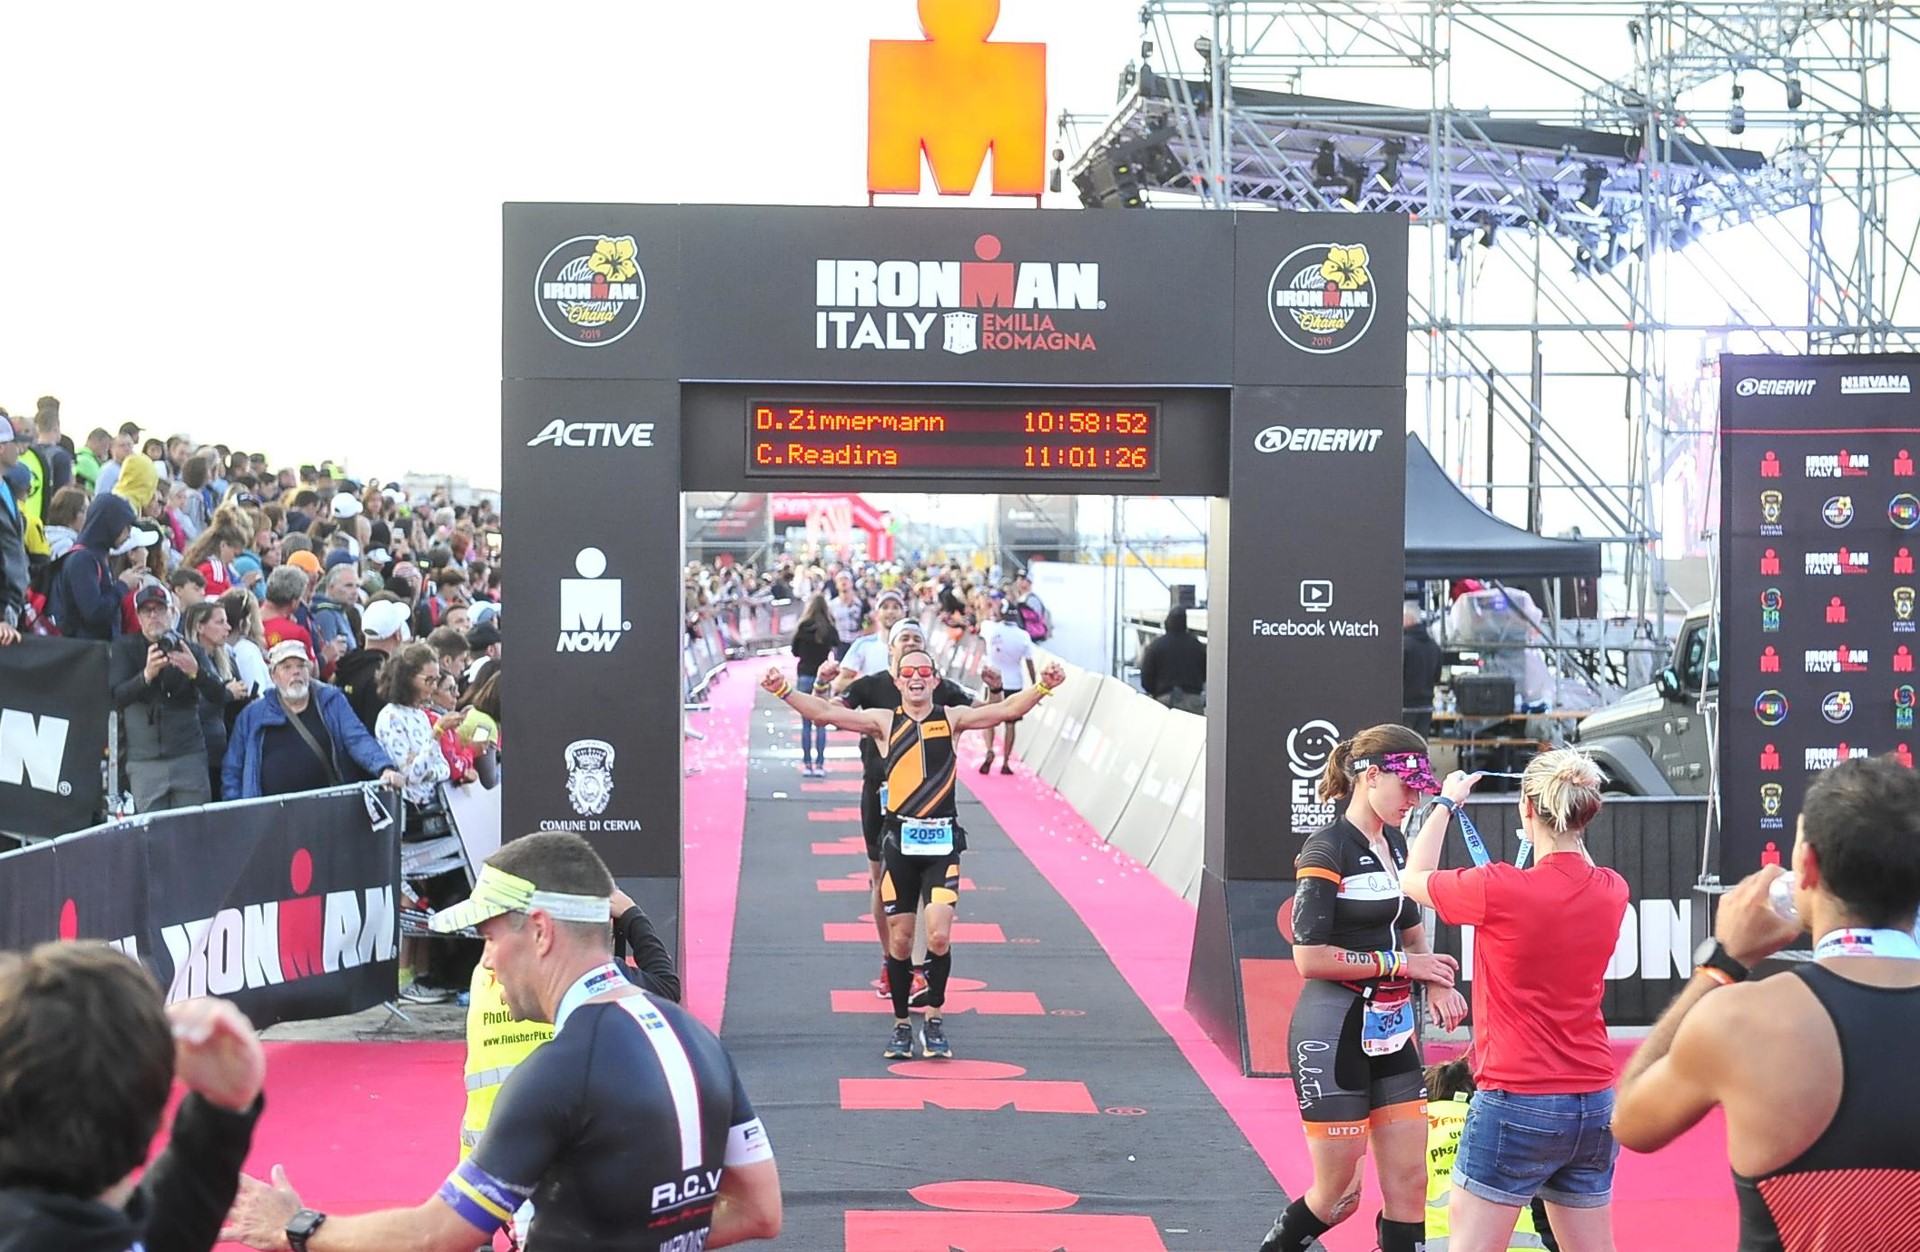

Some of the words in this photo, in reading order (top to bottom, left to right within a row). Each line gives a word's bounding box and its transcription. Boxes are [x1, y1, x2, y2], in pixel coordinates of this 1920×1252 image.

[816, 235, 1104, 311] IRONMAN
[543, 273, 637, 300] IRONMAN
[1276, 281, 1369, 308] IRONMAN
[816, 311, 938, 350] ITALY
[982, 314, 1055, 331] EMILIA
[580, 330, 601, 339] 2019
[982, 332, 1097, 351] ROMAGNA
[1311, 337, 1333, 346] 2019
[1757, 379, 1816, 395] ENERVIT
[1841, 375, 1910, 389] NIRVANA
[756, 409, 945, 432] D.Zimmermann
[1025, 411, 1147, 434] 10:58:52
[527, 419, 654, 447] ACTIVE
[1288, 429, 1383, 452] ENERVIT
[1025, 446, 1147, 468] 11:01:26
[1806, 449, 1869, 467] IRONMAN
[1806, 466, 1833, 477] ITALY
[1805, 547, 1869, 565] IRONMAN
[1805, 564, 1833, 575] ITALY
[1252, 619, 1325, 636] Facebook
[1329, 619, 1379, 637] Watch
[556, 631, 621, 652] NOW
[1805, 645, 1868, 662] IRONMAN
[1805, 662, 1833, 673] ITALY
[1321, 804, 1336, 814] LO
[540, 820, 586, 831] COMUNE
[589, 820, 601, 831] DI
[603, 820, 642, 831] CERVIA
[1291, 813, 1335, 826] SPORT
[909, 828, 945, 840] 2059
[160, 847, 398, 1004] IRONMAN
[1327, 1124, 1367, 1136] WTDT
